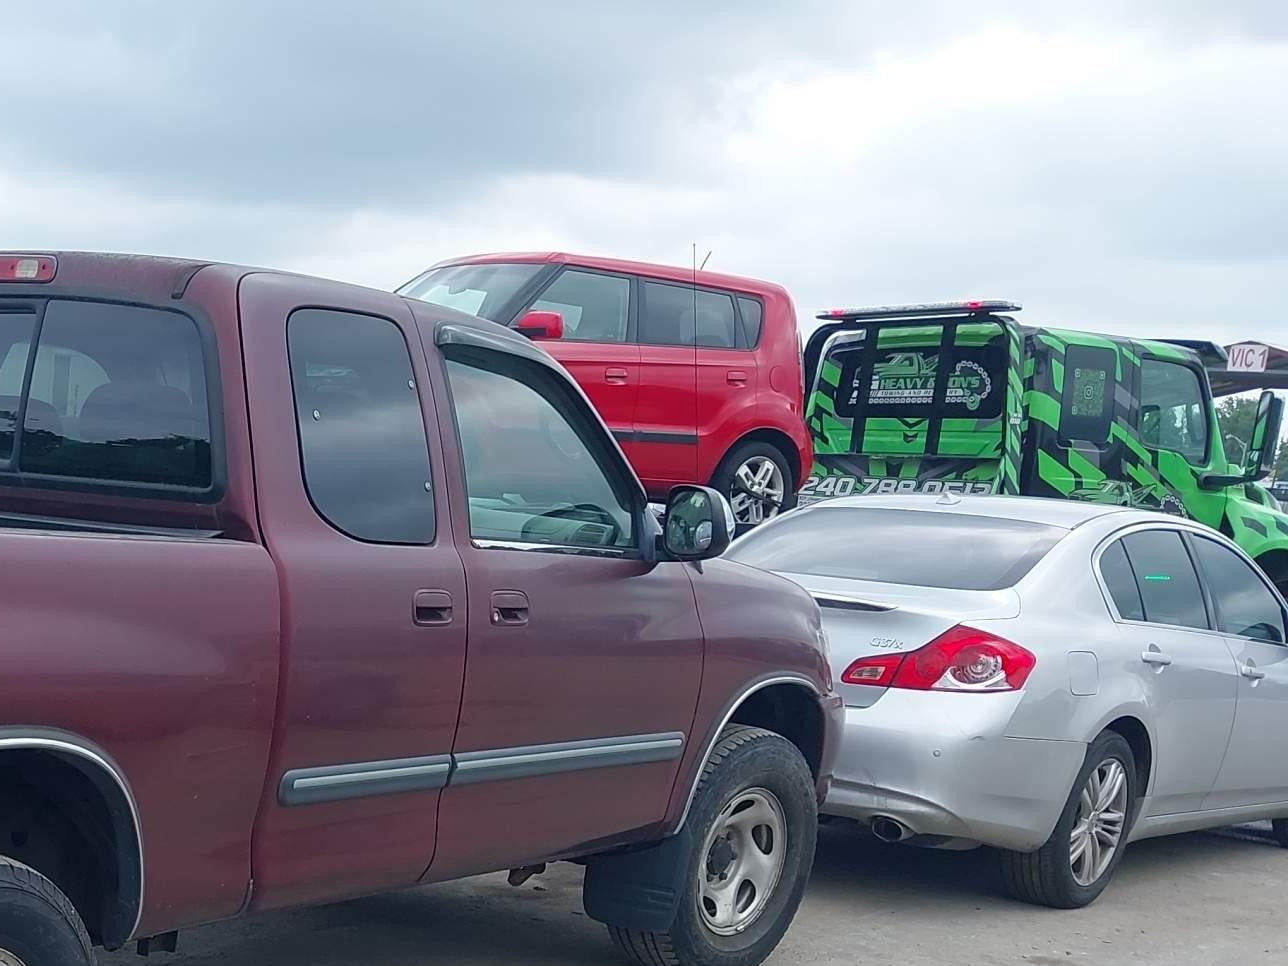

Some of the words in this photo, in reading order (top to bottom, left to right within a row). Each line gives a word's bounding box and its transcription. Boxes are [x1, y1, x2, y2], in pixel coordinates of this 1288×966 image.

[1231, 348, 1255, 368] VIC
[1258, 348, 1267, 369] 1
[879, 377, 924, 389] HEAVY
